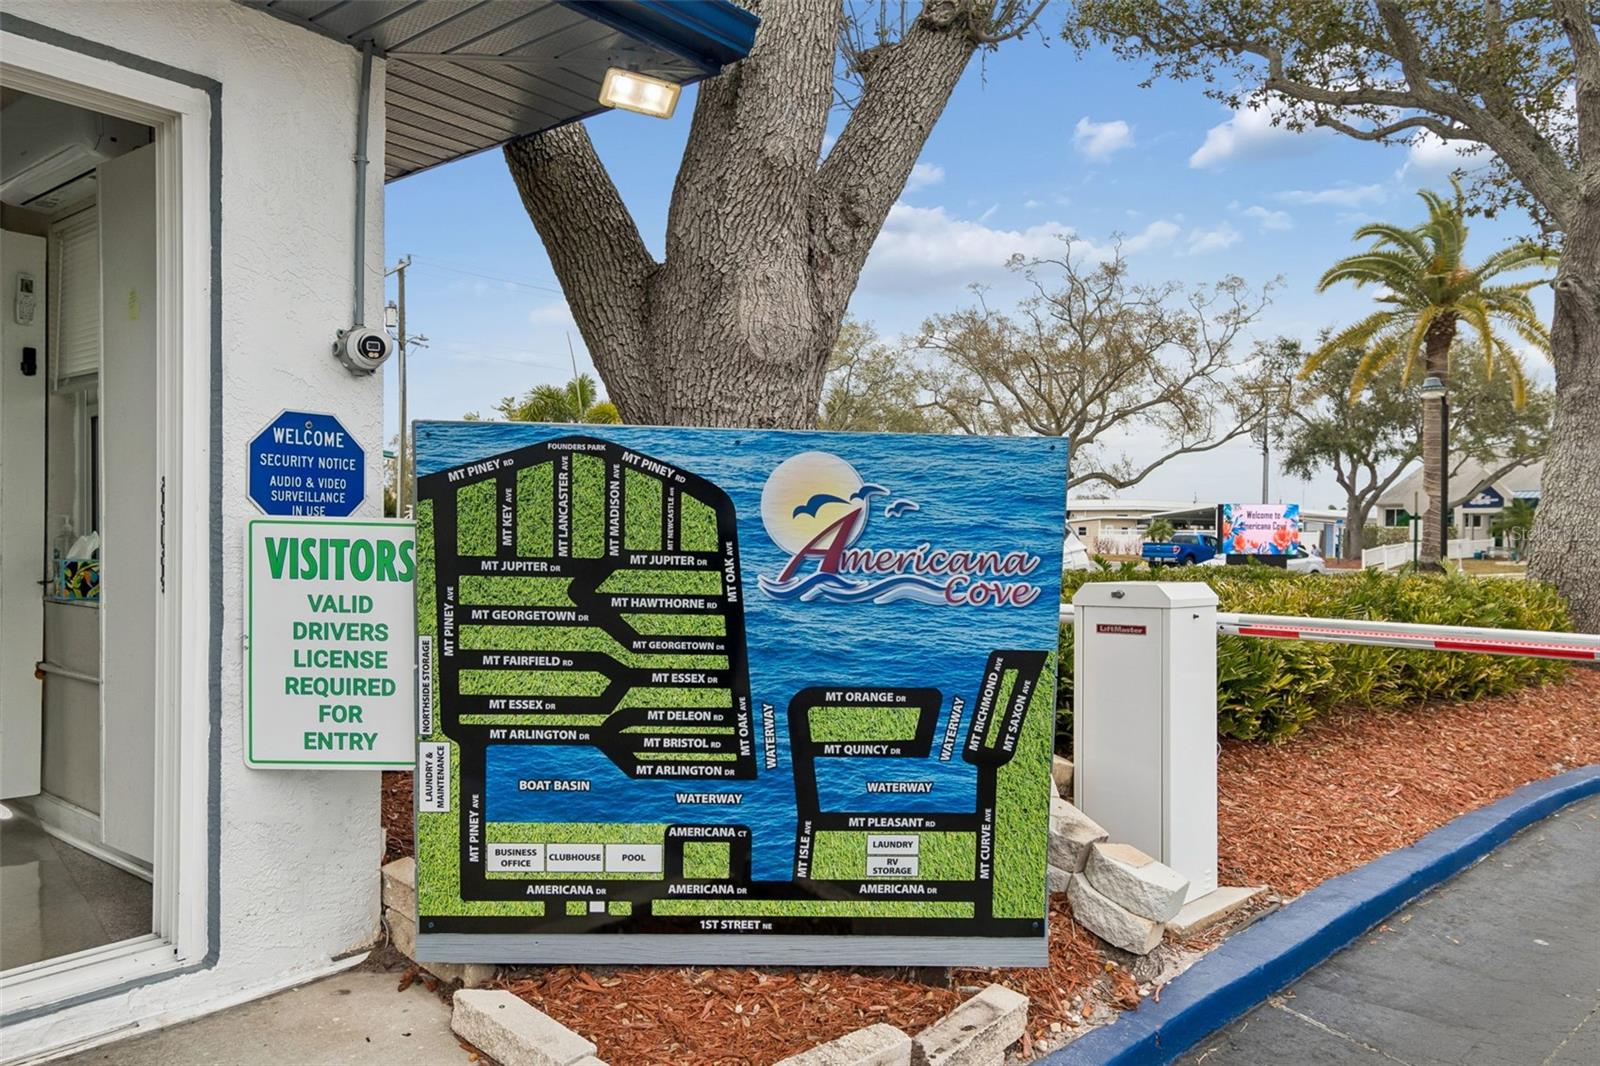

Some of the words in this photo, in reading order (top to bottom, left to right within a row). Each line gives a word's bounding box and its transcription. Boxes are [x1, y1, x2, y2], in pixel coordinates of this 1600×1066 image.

[273, 427, 344, 448] WELCOME
[260, 453, 314, 468] SECURITY
[318, 457, 356, 470] NOTICE
[621, 452, 640, 463] MT
[642, 458, 675, 478] PINEY
[675, 474, 686, 483] RD
[448, 469, 467, 482] MT
[468, 459, 501, 477] PINEY
[503, 458, 514, 467] RD
[269, 475, 302, 488] AUDIO
[306, 477, 314, 488] &
[318, 478, 346, 489] VIDEO
[271, 490, 345, 503] SURVEILLANCE
[292, 506, 302, 516] IN
[306, 507, 325, 516] USE
[559, 472, 568, 539] LANCASTER
[610, 481, 619, 538] MADISON
[503, 505, 512, 529] KEY
[1247, 511, 1272, 519] Welcome
[503, 531, 512, 546] MT
[668, 540, 673, 550] MT
[559, 541, 568, 557] MT
[610, 540, 619, 556] MT
[265, 537, 415, 582] VISITORS
[481, 561, 498, 571] MT
[501, 561, 548, 572] JUPITER
[550, 564, 561, 572] DR
[630, 555, 647, 565] MT
[649, 555, 694, 566] JUPITER
[696, 558, 707, 566] DR
[726, 558, 735, 584] OAK
[727, 586, 737, 602] MT
[945, 577, 1040, 606] Cove
[308, 595, 373, 613] VALID
[611, 597, 628, 608] MT
[630, 597, 705, 609] HAWTHORNE
[444, 603, 455, 639] PINEY
[472, 610, 489, 620] MT
[491, 610, 576, 621] GEORGETOWN
[293, 623, 389, 641] DRIVERS
[444, 641, 454, 656] MT
[633, 641, 646, 649] MT
[647, 641, 714, 650] GEORGETOWN
[294, 650, 388, 669] LICENSE
[422, 640, 430, 677] STORAGE
[483, 656, 499, 666] MT
[502, 656, 560, 667] FAIRFIELD
[562, 659, 573, 667] RD
[995, 656, 1003, 672] AVE
[652, 673, 669, 683] MT
[671, 673, 705, 683] ESSEX
[285, 677, 396, 697] REQUIRED
[489, 699, 506, 710] MT
[509, 700, 543, 710] ESSEX
[826, 692, 843, 701] MT
[845, 692, 894, 702] ORANGE
[974, 671, 999, 732] RICHMOND
[319, 705, 362, 723] FOR
[648, 711, 665, 721] MT
[667, 711, 711, 721] DELEON
[1003, 734, 1015, 752] MT
[1010, 694, 1027, 734] SAXON
[1023, 679, 1031, 694] AVE
[737, 713, 749, 738] OAK
[940, 697, 965, 762] WATERWAY
[304, 732, 378, 750] ENTRY
[490, 730, 507, 740] MT
[508, 730, 577, 741] ARLINGTON
[644, 738, 660, 747] MT
[662, 738, 708, 748] BRISTOL
[762, 704, 777, 769] WATERWAY
[969, 733, 982, 751] MT
[740, 739, 750, 756] MT
[824, 745, 842, 754] MT
[844, 745, 888, 755] QUINCY
[436, 745, 445, 808] MAINTENANCE
[636, 765, 653, 775] MT
[655, 765, 722, 776] ARLINGTON
[425, 760, 433, 802] LAUNDRY
[519, 780, 551, 791] BOAT
[554, 780, 590, 791] BASIN
[866, 782, 933, 793] WATERWAY
[676, 793, 743, 804] WATERWAY
[469, 811, 479, 844] PINEY
[803, 820, 812, 835] AVE
[849, 818, 866, 827] MT
[868, 818, 924, 828] PLEASANT
[669, 827, 735, 837] AMERICANA
[800, 836, 810, 860] ISLE
[873, 841, 913, 849] LAUNDRY
[981, 823, 990, 860] CURVE
[469, 846, 479, 863] MT
[495, 848, 537, 857] BUSINESS
[549, 853, 601, 862] CLUBHOUSE
[622, 853, 646, 862] POOL
[500, 859, 531, 867] OFFICE
[797, 861, 808, 878] MT
[887, 858, 898, 866] RV
[873, 867, 912, 875] STORAGE
[980, 862, 989, 879] MT
[526, 885, 594, 895] AMERICANA
[668, 884, 735, 894] AMERICANA
[859, 884, 925, 895] AMERICANA
[700, 920, 718, 930] 1ST
[720, 920, 761, 930] STREET
